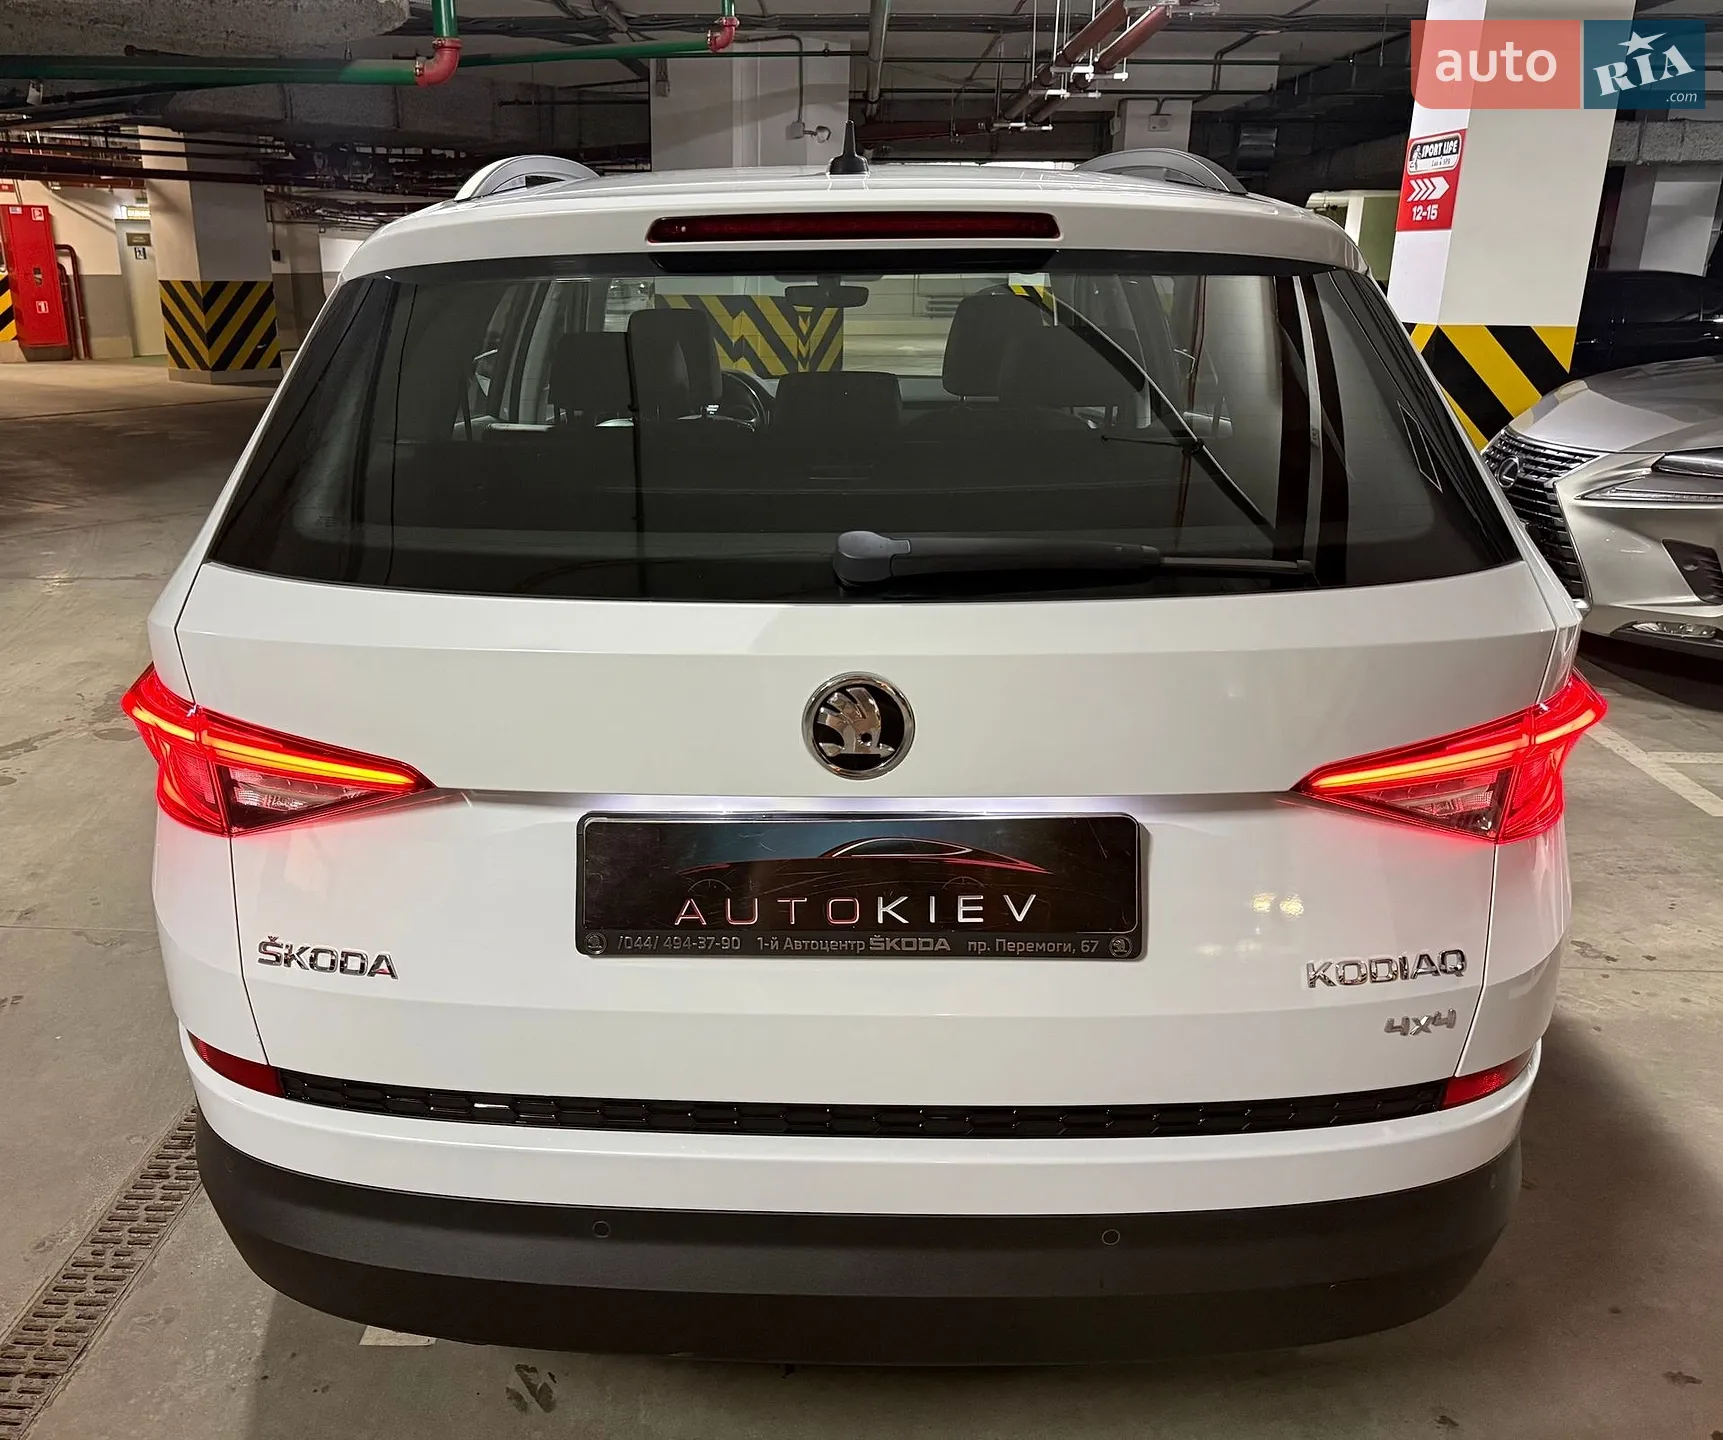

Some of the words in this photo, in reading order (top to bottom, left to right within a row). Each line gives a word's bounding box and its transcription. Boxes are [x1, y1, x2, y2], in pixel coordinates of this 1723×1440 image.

[1421, 142, 1443, 158] SPORT
[1412, 204, 1439, 221] 12-15
[663, 936, 741, 950] 494-37-90
[757, 935, 779, 950] 1-й
[783, 937, 865, 953] Автоцентр
[869, 934, 951, 951] ŠKODA
[968, 939, 990, 952] пр.
[995, 938, 1076, 954] Перемоги,
[1081, 940, 1099, 953] 67
[257, 935, 399, 980] ŠKODA
[1306, 949, 1468, 988] KODIAQ
